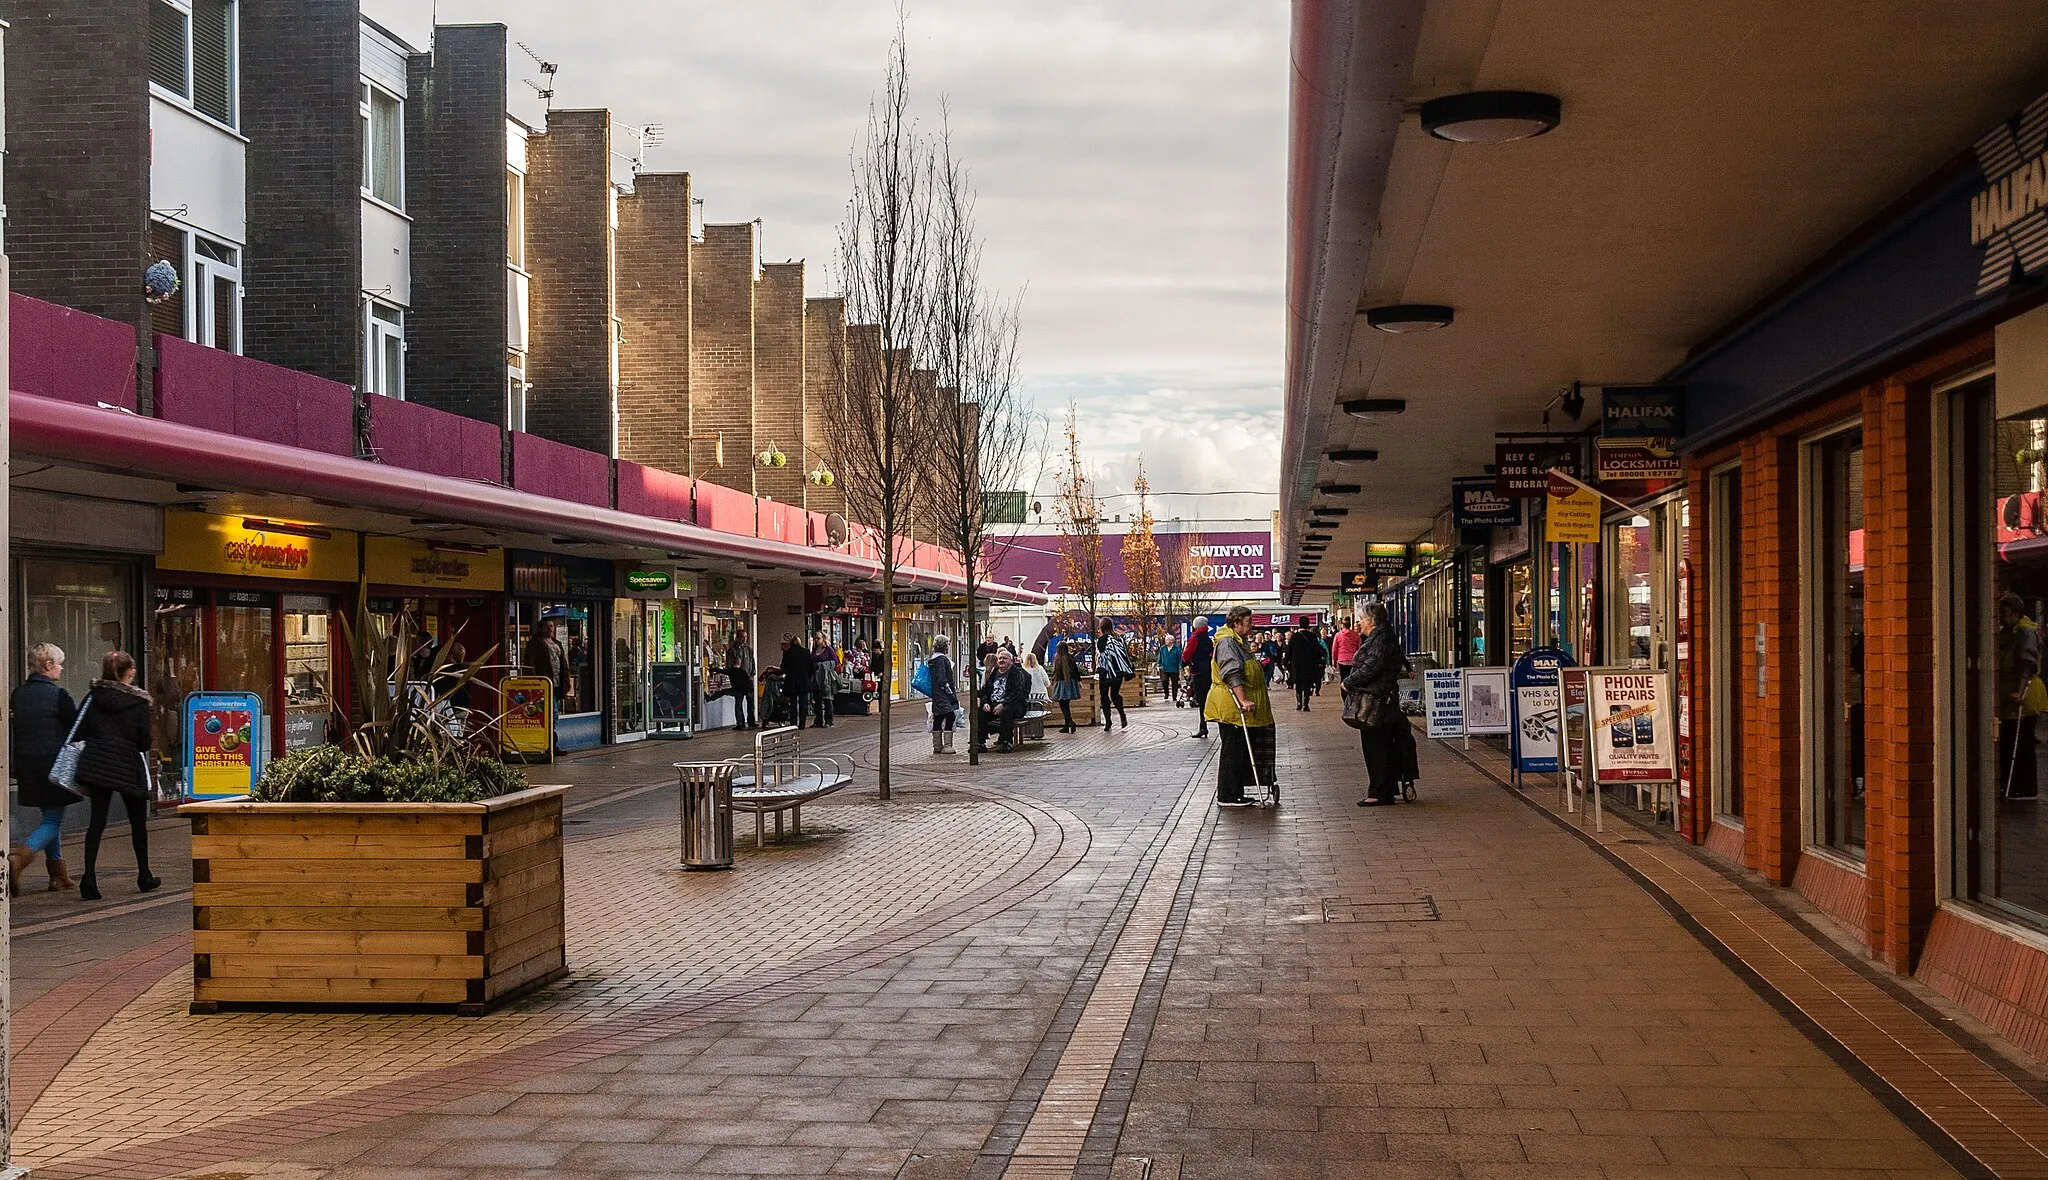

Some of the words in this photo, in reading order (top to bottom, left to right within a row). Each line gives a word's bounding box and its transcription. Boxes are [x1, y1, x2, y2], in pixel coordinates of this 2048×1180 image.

[1607, 405, 1676, 418] HALIFAX
[1505, 453, 1524, 461] KEY
[1603, 460, 1680, 469] LOCKSMITH
[1501, 466, 1528, 475] SHOE
[1494, 516, 1515, 524] Expert
[1190, 545, 1264, 557] SWINTON
[1190, 564, 1264, 580] SQUARE
[629, 576, 668, 585] Specsavers
[897, 593, 938, 602] BETFRED
[1533, 659, 1559, 667] MAX
[1433, 681, 1460, 689] Mobile
[1604, 676, 1654, 689] PHONE
[1434, 690, 1461, 700] Laptop
[1522, 690, 1541, 698] VHS
[1543, 690, 1552, 698] &
[1605, 690, 1655, 701] REPAIRS
[1601, 714, 1625, 726] SPEEDY
[1625, 704, 1650, 718] SERVICE
